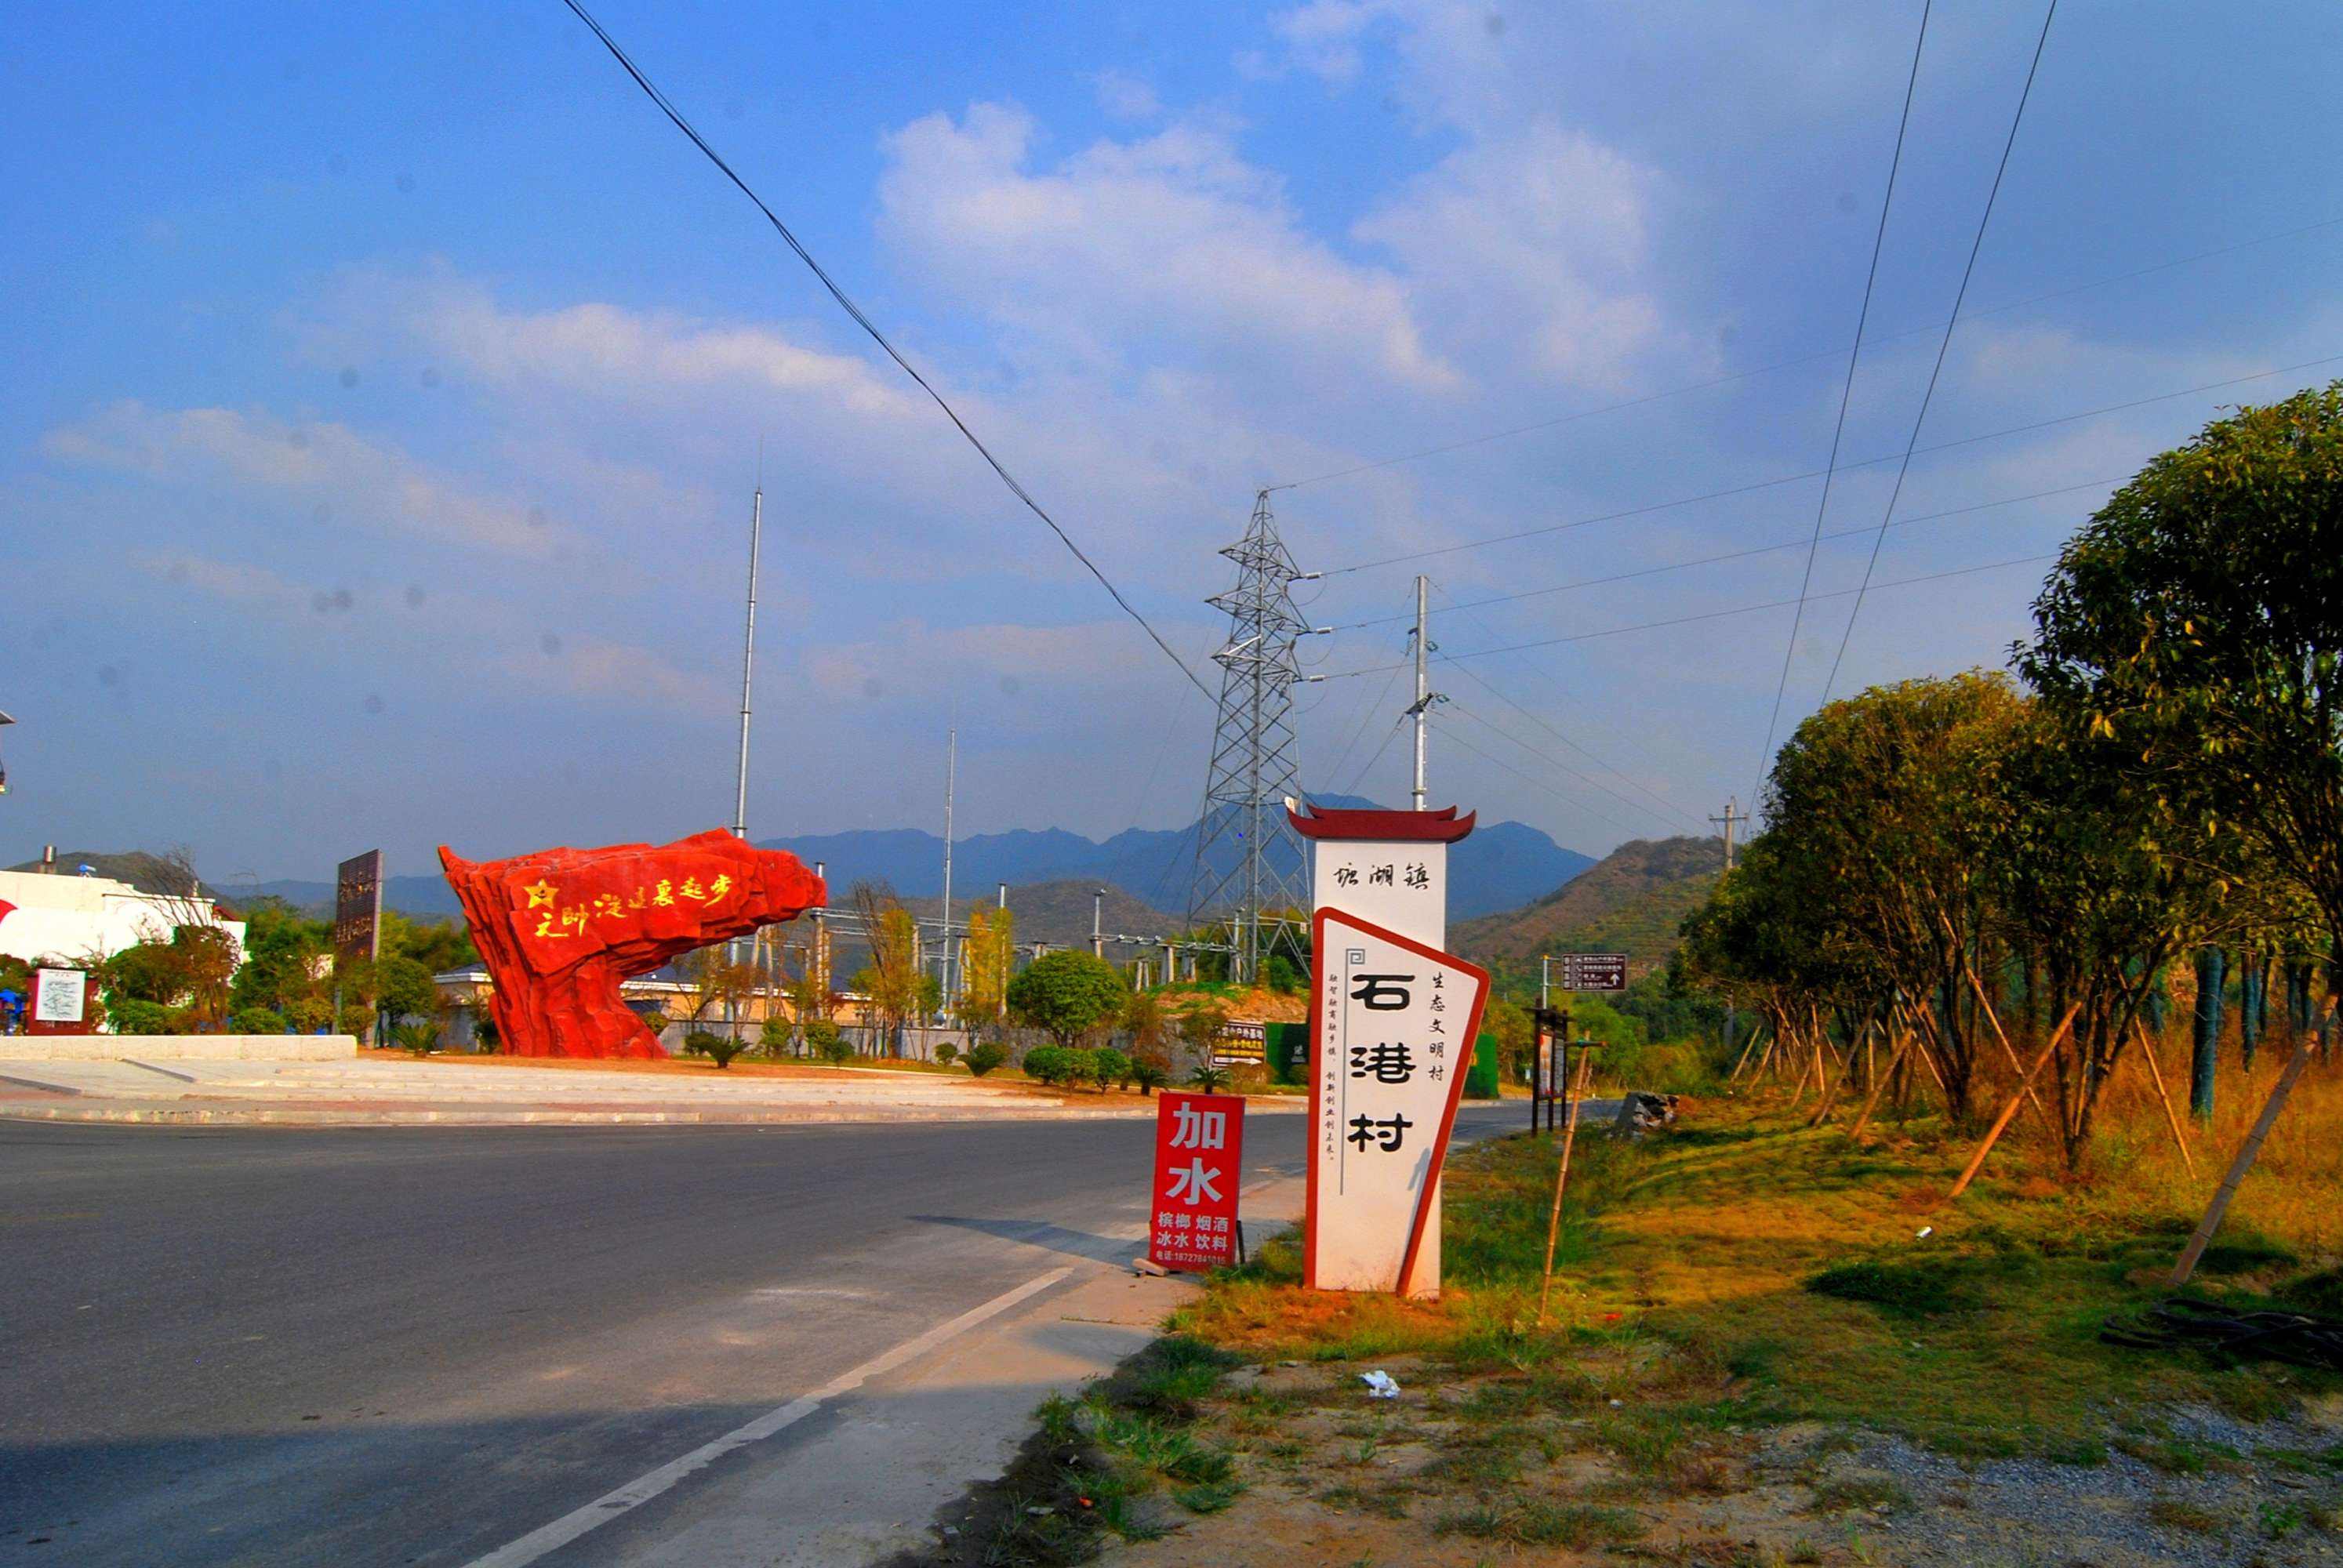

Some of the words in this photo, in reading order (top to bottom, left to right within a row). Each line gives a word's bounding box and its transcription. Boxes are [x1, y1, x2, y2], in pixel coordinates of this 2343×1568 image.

[1347, 974, 1416, 1153] 石港村
[1427, 971, 1446, 1082] 生态文明村
[1167, 1102, 1226, 1206] 加水
[1156, 1231, 1190, 1248] 冰水
[1195, 1234, 1228, 1251] 饮料
[1157, 1211, 1191, 1229] 槟榔
[1196, 1214, 1230, 1232] 烟酒
